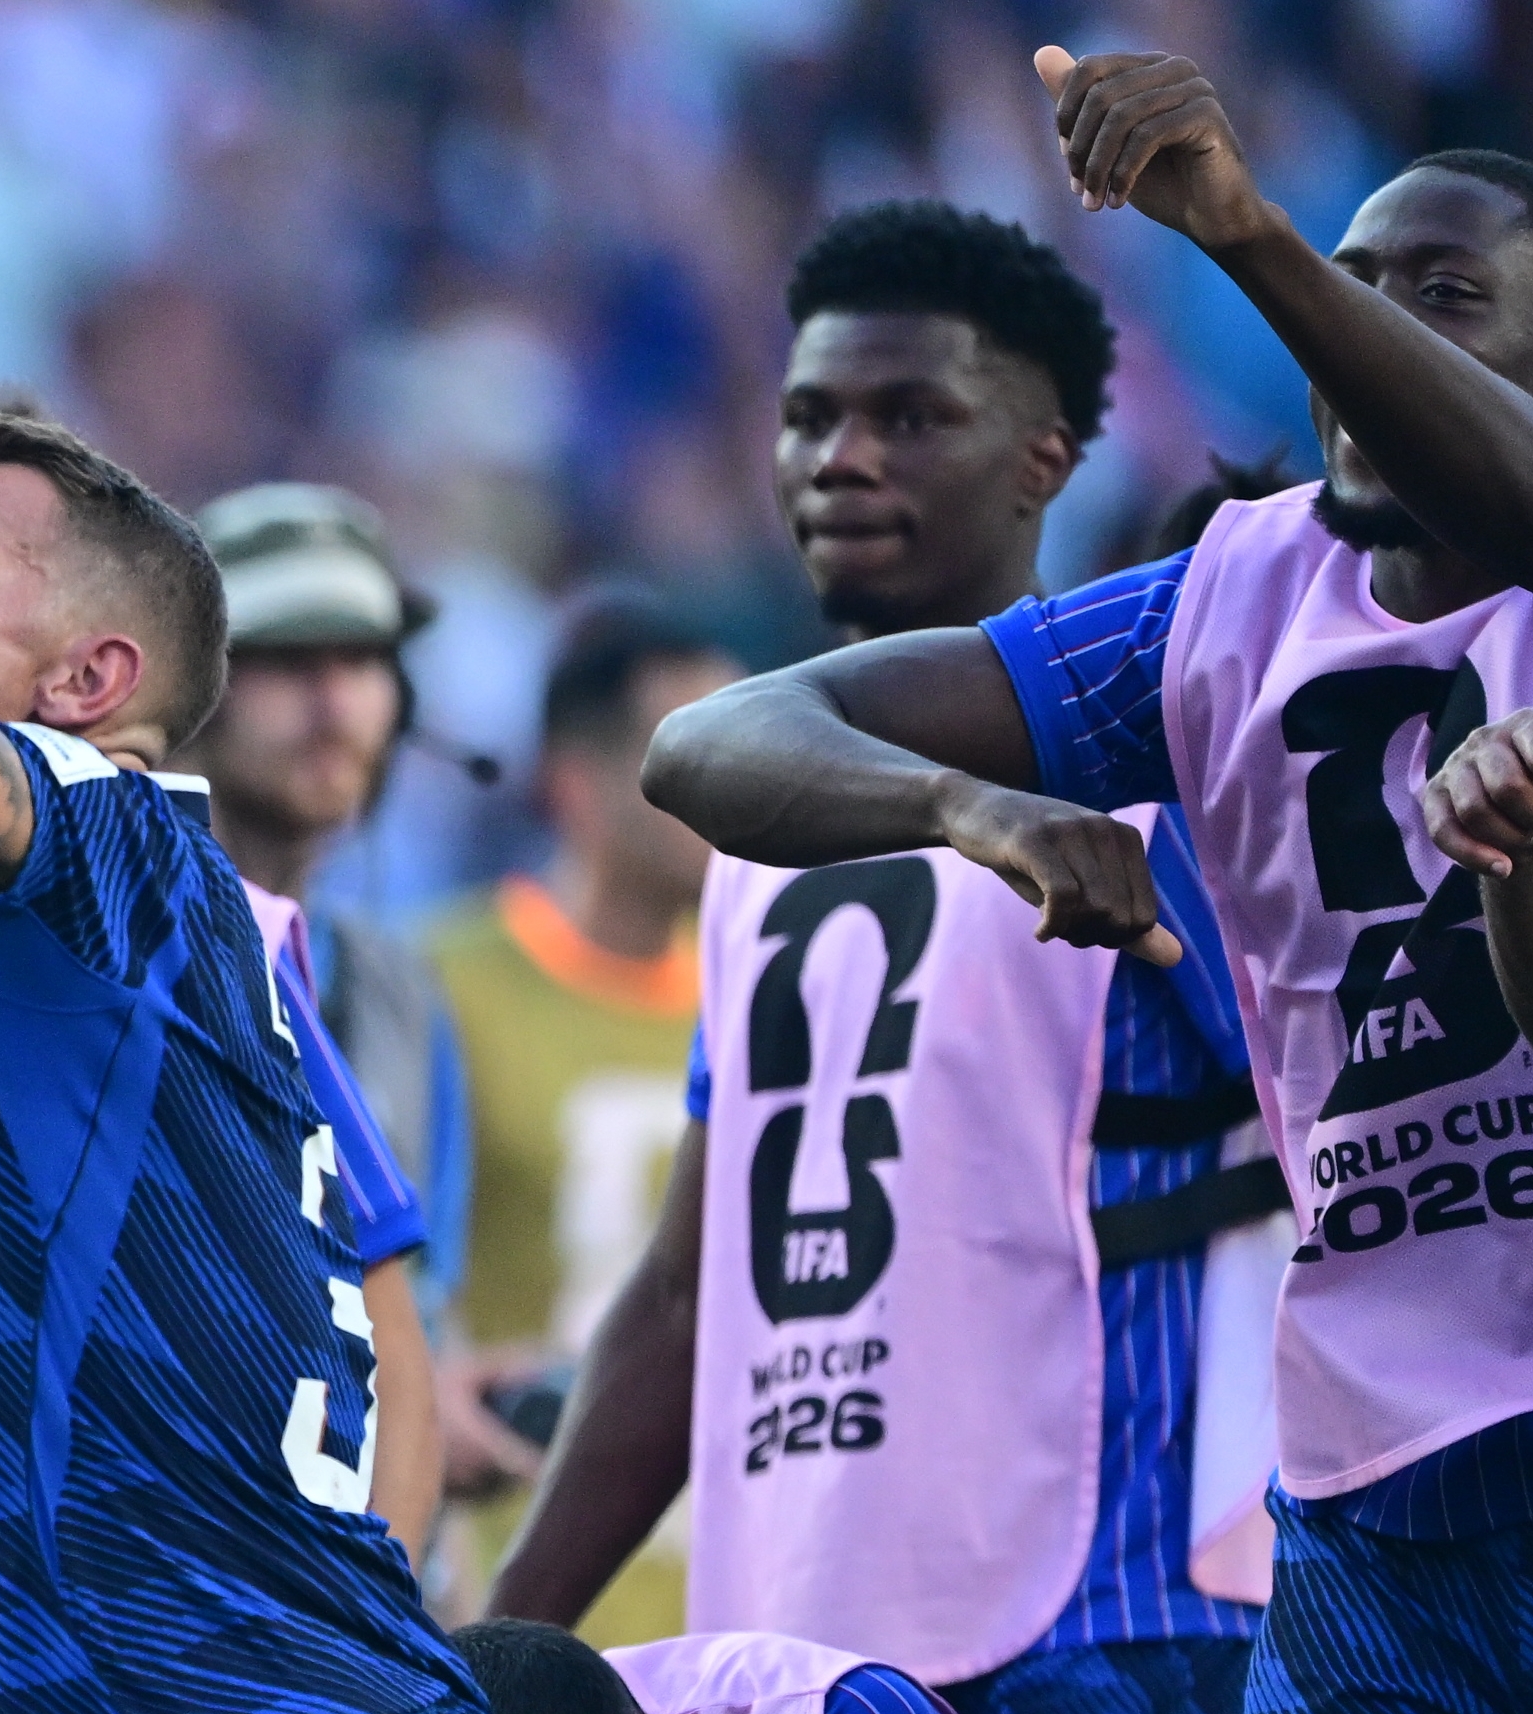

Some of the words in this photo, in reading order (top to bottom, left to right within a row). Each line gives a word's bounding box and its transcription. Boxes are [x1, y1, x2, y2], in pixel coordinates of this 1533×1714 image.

[1352, 997, 1447, 1064] IFA
[1309, 1120, 1434, 1193] ORLD
[782, 1227, 849, 1285] IFA
[746, 1390, 887, 1475] 226
